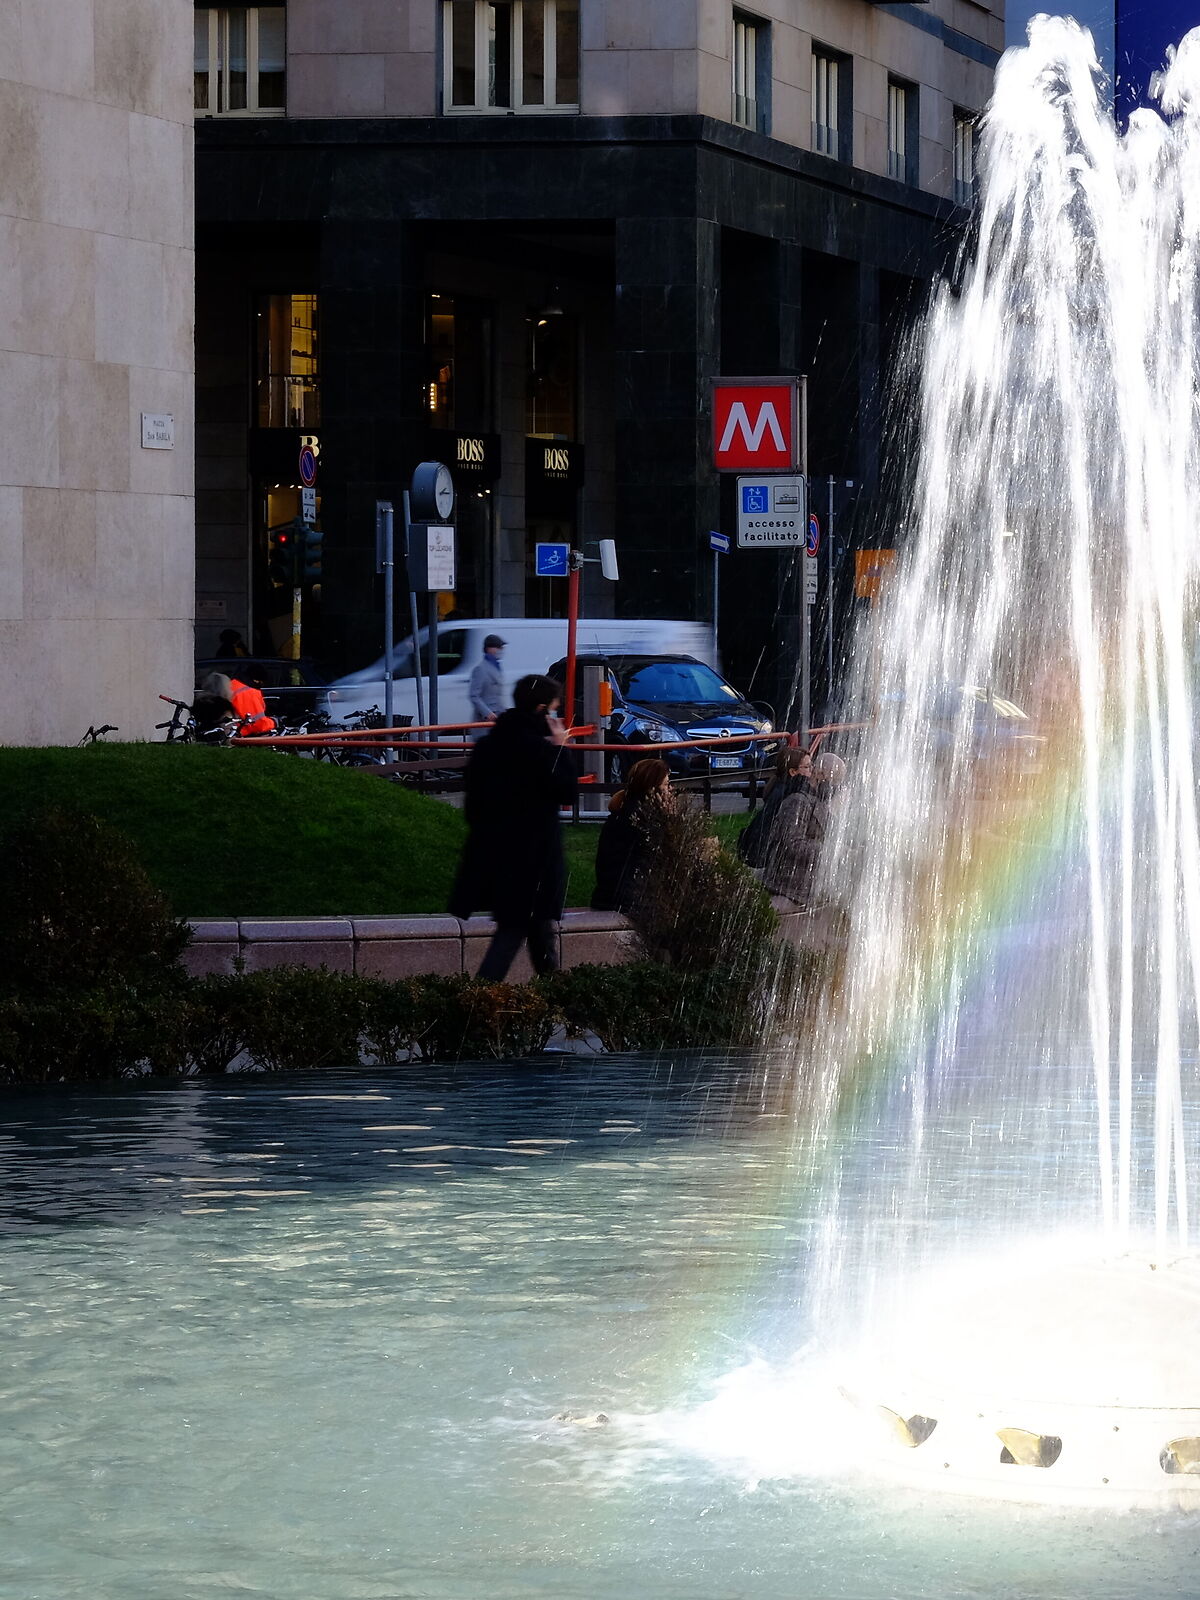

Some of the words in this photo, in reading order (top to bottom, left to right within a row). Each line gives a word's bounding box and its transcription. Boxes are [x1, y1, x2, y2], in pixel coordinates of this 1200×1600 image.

[718, 401, 787, 451] M
[457, 438, 484, 462] BOSS
[544, 447, 569, 471] BOSS
[748, 520, 795, 528] accesso
[744, 532, 799, 541] facilitato
